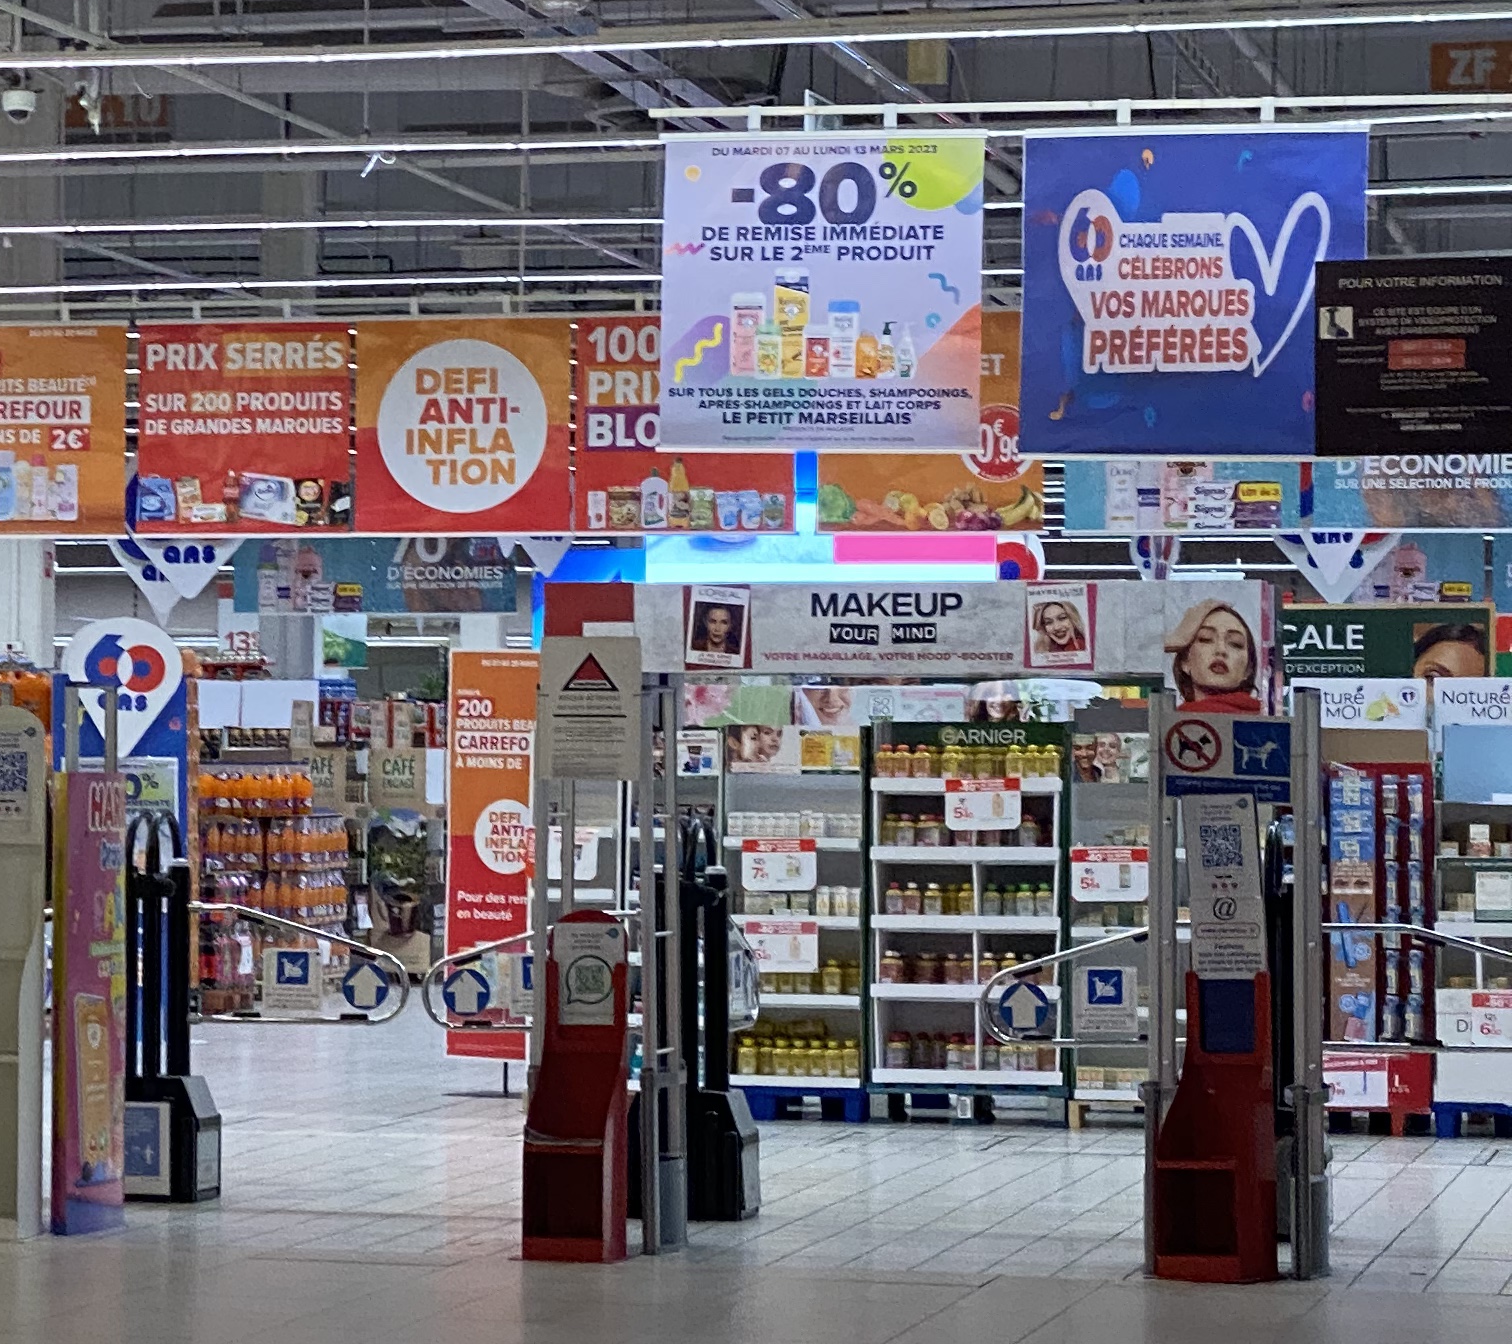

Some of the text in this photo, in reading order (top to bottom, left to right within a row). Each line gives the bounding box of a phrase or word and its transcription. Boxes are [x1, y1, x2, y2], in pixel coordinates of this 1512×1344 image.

[712, 146, 727, 157] DU
[733, 146, 770, 156] MARDI
[793, 146, 810, 156] AU
[813, 146, 851, 156] LUNDI
[869, 145, 905, 155] MARS
[731, 161, 918, 226] -80%
[702, 222, 944, 241] DE REMISE IMMÉDIATE
[1119, 233, 1168, 248] CHAQUE
[710, 246, 754, 261] SUR
[761, 247, 785, 261] LE
[837, 245, 935, 261] PRODUIT
[1118, 256, 1224, 281] CÉLÉBRONS
[1338, 275, 1502, 289] POUR VOTRE INFORMATION
[1091, 288, 1250, 319] VOS MARQUES
[1089, 324, 1249, 366] PRÉFÉRÉES
[146, 336, 345, 372] PRIX SERRÉS
[415, 367, 499, 396] DEFI
[145, 391, 342, 412] SUR 200 PRODUITS
[669, 388, 695, 398] SUR
[698, 388, 734, 398] TOUS
[736, 388, 759, 398] LES
[762, 388, 795, 398] GELS
[419, 399, 521, 425] ANTI-
[846, 399, 861, 409] ET
[864, 399, 893, 409] LAIT
[896, 399, 941, 410] CORPS
[145, 418, 343, 435] DE GRANDES MARQUES
[722, 412, 912, 425] LE PETIT MARSEILLAIS
[19, 429, 41, 444] DE
[405, 427, 515, 455] INFLA
[425, 458, 516, 486] TION
[1334, 479, 1359, 489] SUR
[1361, 478, 1387, 489] UNE
[1389, 476, 1451, 489] SÉLECTION
[1454, 478, 1472, 489] DE
[163, 543, 216, 564] ans
[810, 592, 963, 618] MAKEUP
[830, 626, 936, 642] YOUR MIND
[1285, 663, 1365, 674] D'EXCEPTION
[457, 699, 493, 716] 200
[1325, 703, 1361, 720] MOI
[1471, 703, 1507, 720] MOI
[455, 719, 511, 732] PRODUITS
[941, 727, 1027, 745] GARNIER
[455, 754, 523, 770] À MOINS DE
[457, 890, 506, 904] Pour des
[456, 907, 513, 922] en beauté
